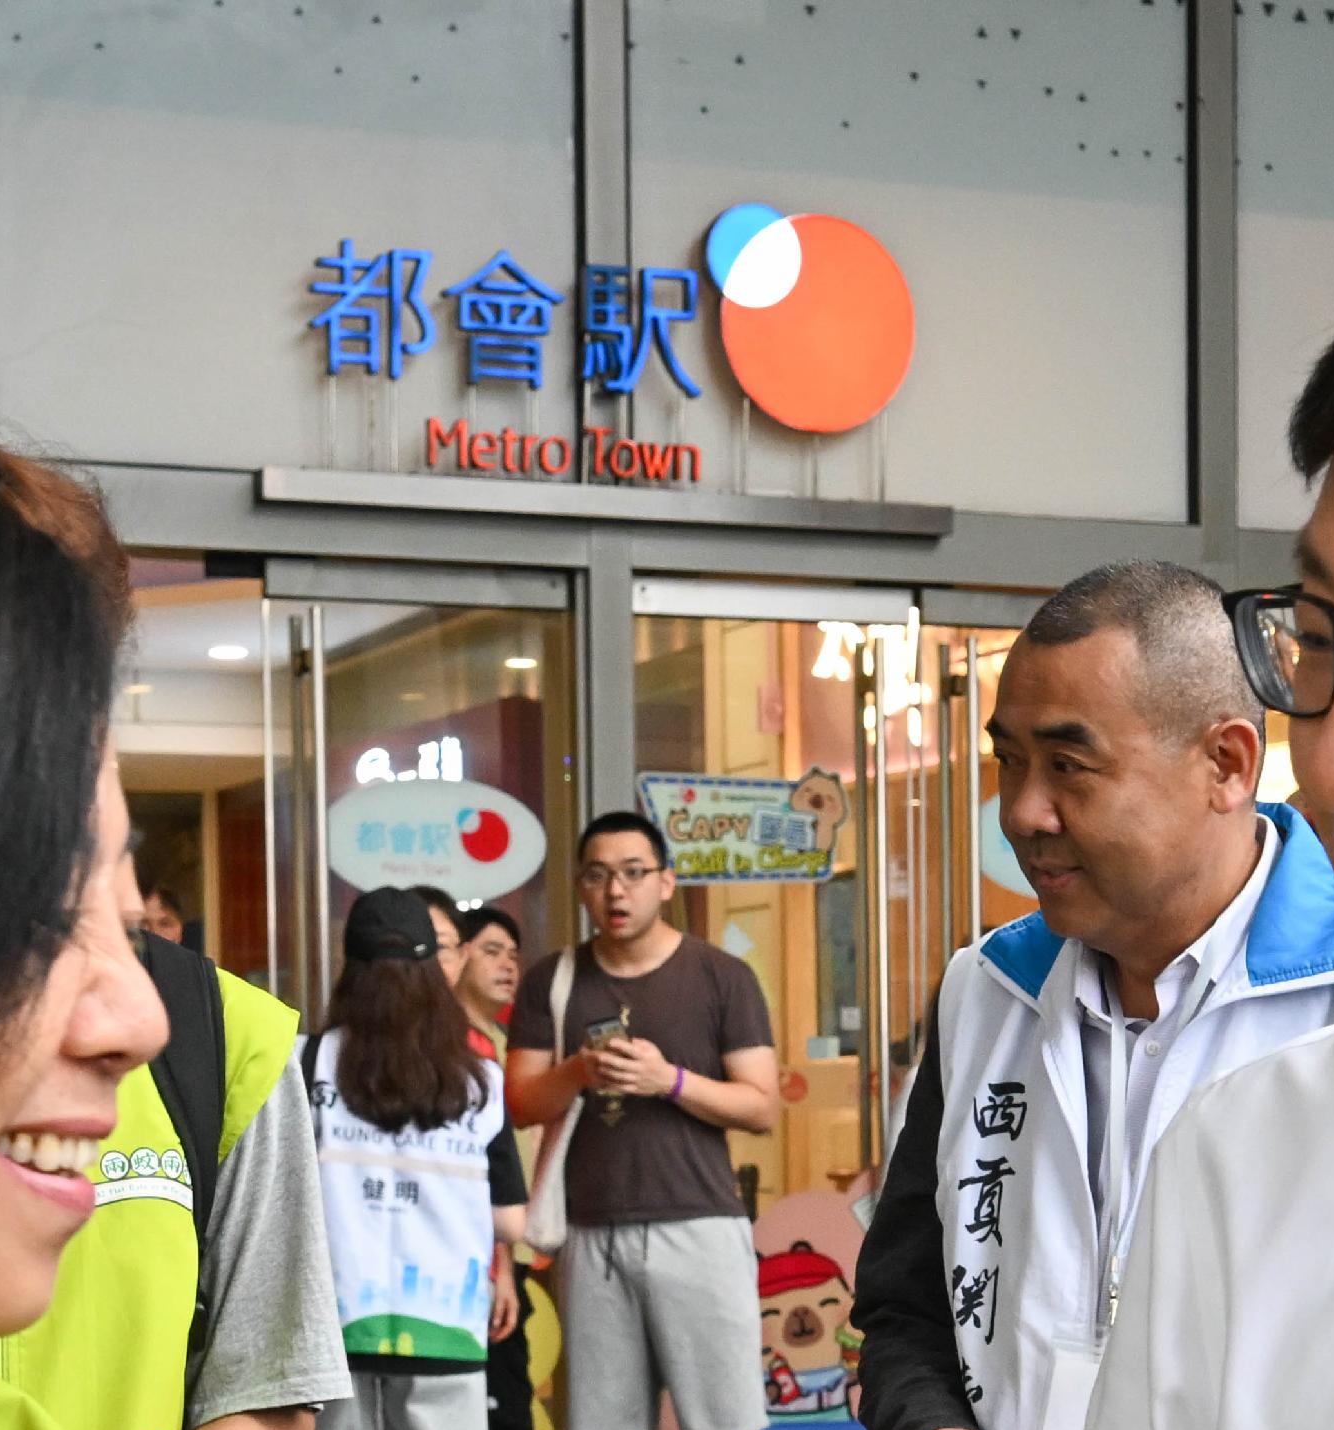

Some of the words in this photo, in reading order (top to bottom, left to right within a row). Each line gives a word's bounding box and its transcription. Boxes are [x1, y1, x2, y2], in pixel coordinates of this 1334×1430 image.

[309, 237, 703, 398] 都會駅
[426, 416, 573, 476] Metro
[587, 426, 702, 481] Town
[667, 809, 752, 843] CAPY
